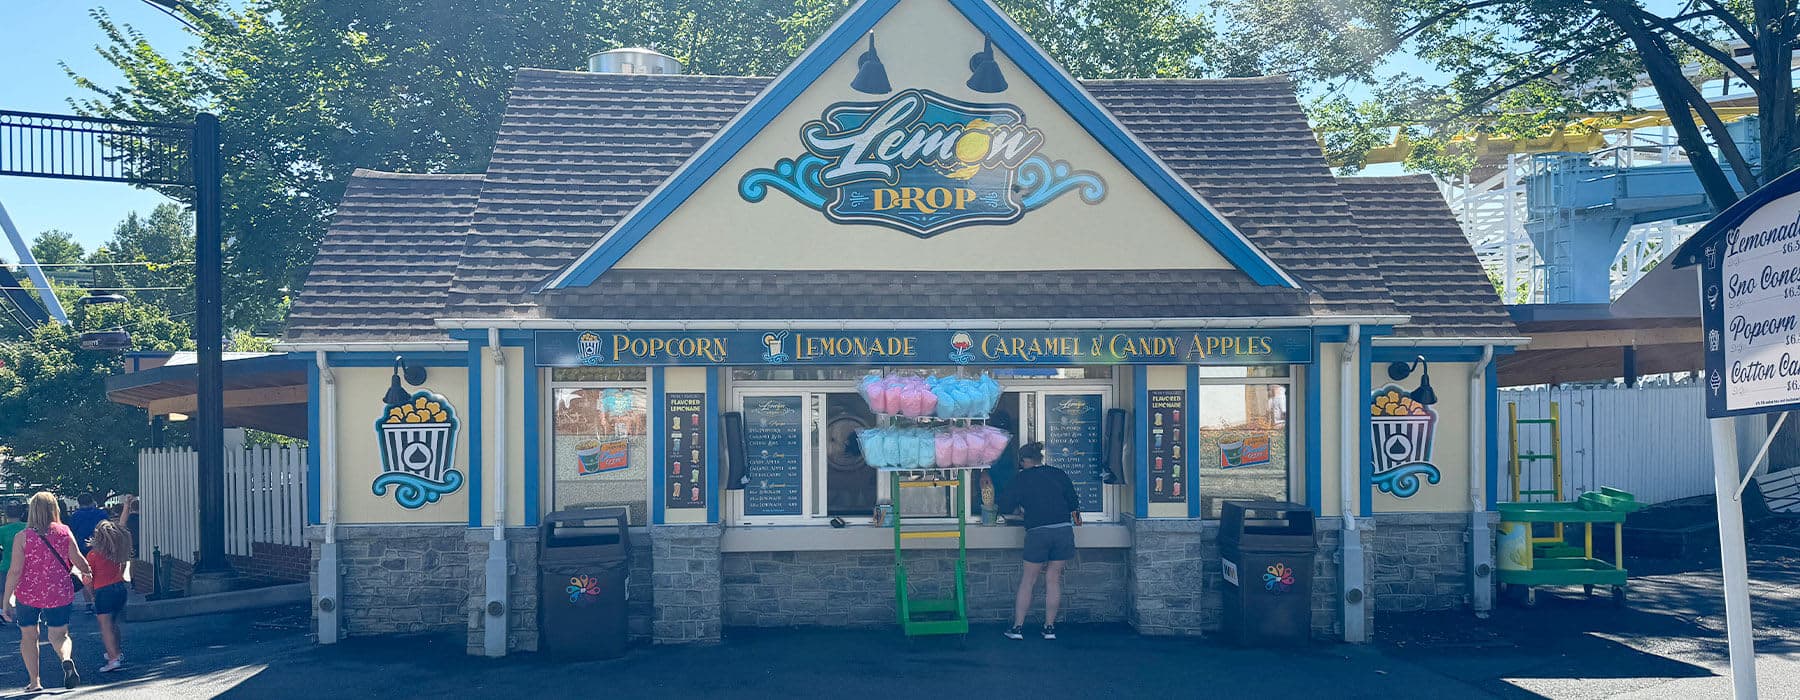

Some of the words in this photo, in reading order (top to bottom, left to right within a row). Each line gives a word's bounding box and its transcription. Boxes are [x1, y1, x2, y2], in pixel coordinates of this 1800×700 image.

[806, 95, 1036, 179] Lemon
[871, 187, 977, 213] DROP
[1727, 212, 1800, 258] Lemonad
[1728, 273, 1756, 299] Sno
[1729, 315, 1798, 345] Popcorn
[613, 335, 729, 363] POPCORN
[796, 333, 917, 361] LEMONADE
[981, 333, 1085, 362] CARAMEL
[1090, 335, 1104, 357] &
[1109, 333, 1182, 360] CANDY
[1186, 332, 1273, 361] APPLES
[1731, 360, 1776, 384] Cotton
